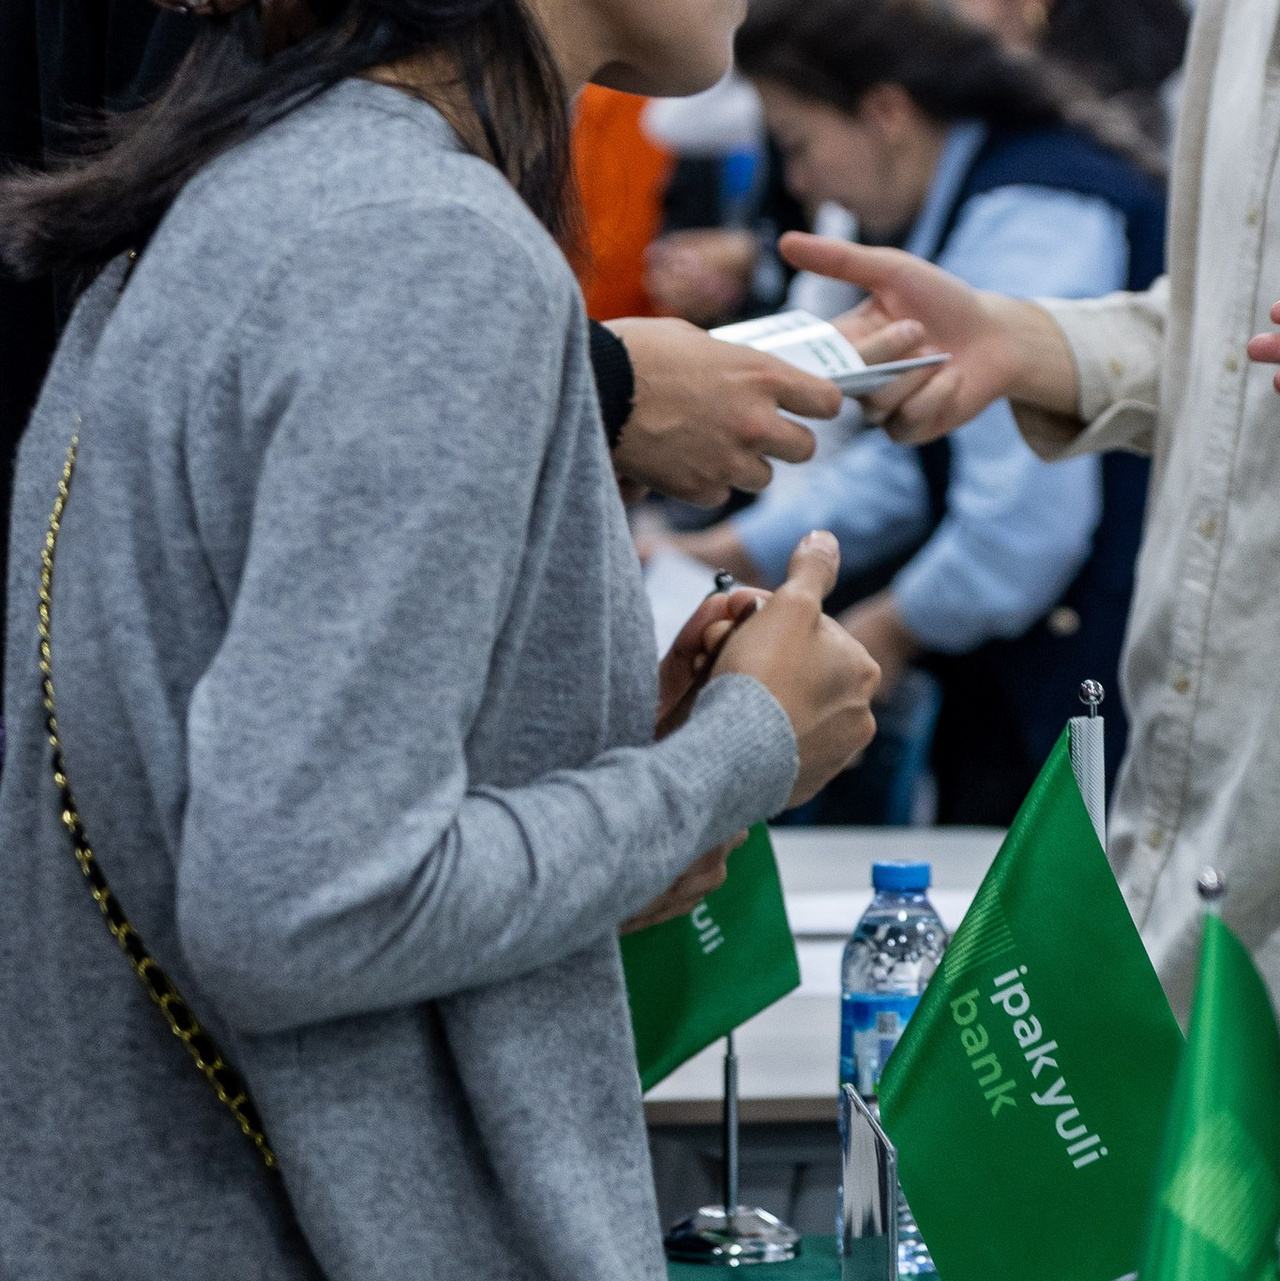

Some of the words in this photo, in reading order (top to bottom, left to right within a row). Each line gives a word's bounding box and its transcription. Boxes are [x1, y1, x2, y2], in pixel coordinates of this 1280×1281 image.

[690, 902, 725, 955] uli
[950, 987, 1018, 1120] bank
[989, 964, 1059, 1080] ipak
[1030, 1075, 1109, 1170] yuli
